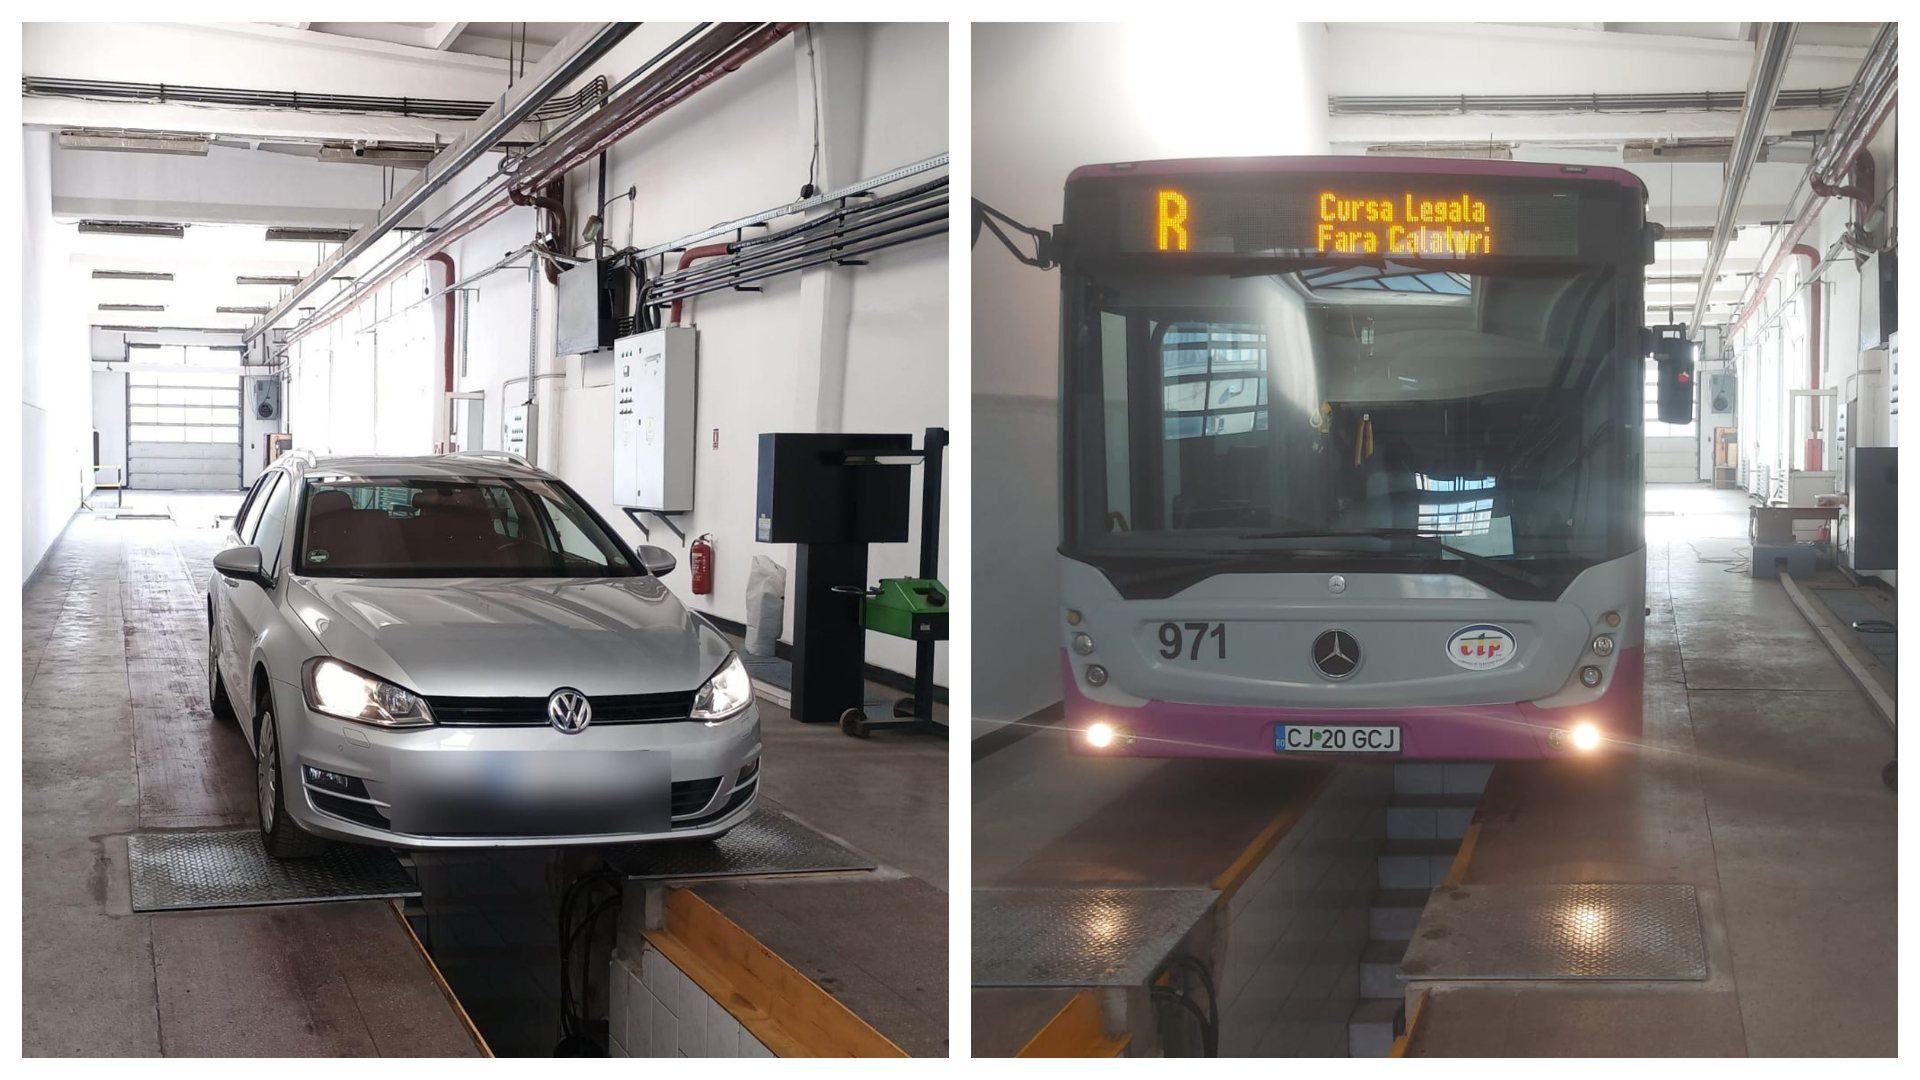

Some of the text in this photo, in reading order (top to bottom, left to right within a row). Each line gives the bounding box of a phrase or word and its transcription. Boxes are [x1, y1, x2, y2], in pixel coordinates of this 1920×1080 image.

[1159, 190, 1187, 250] R
[1320, 193, 1486, 223] Cursa Legala
[1318, 224, 1377, 253] Fara
[1159, 622, 1226, 660] 971
[1288, 728, 1394, 749] CJ 20 GCJ
